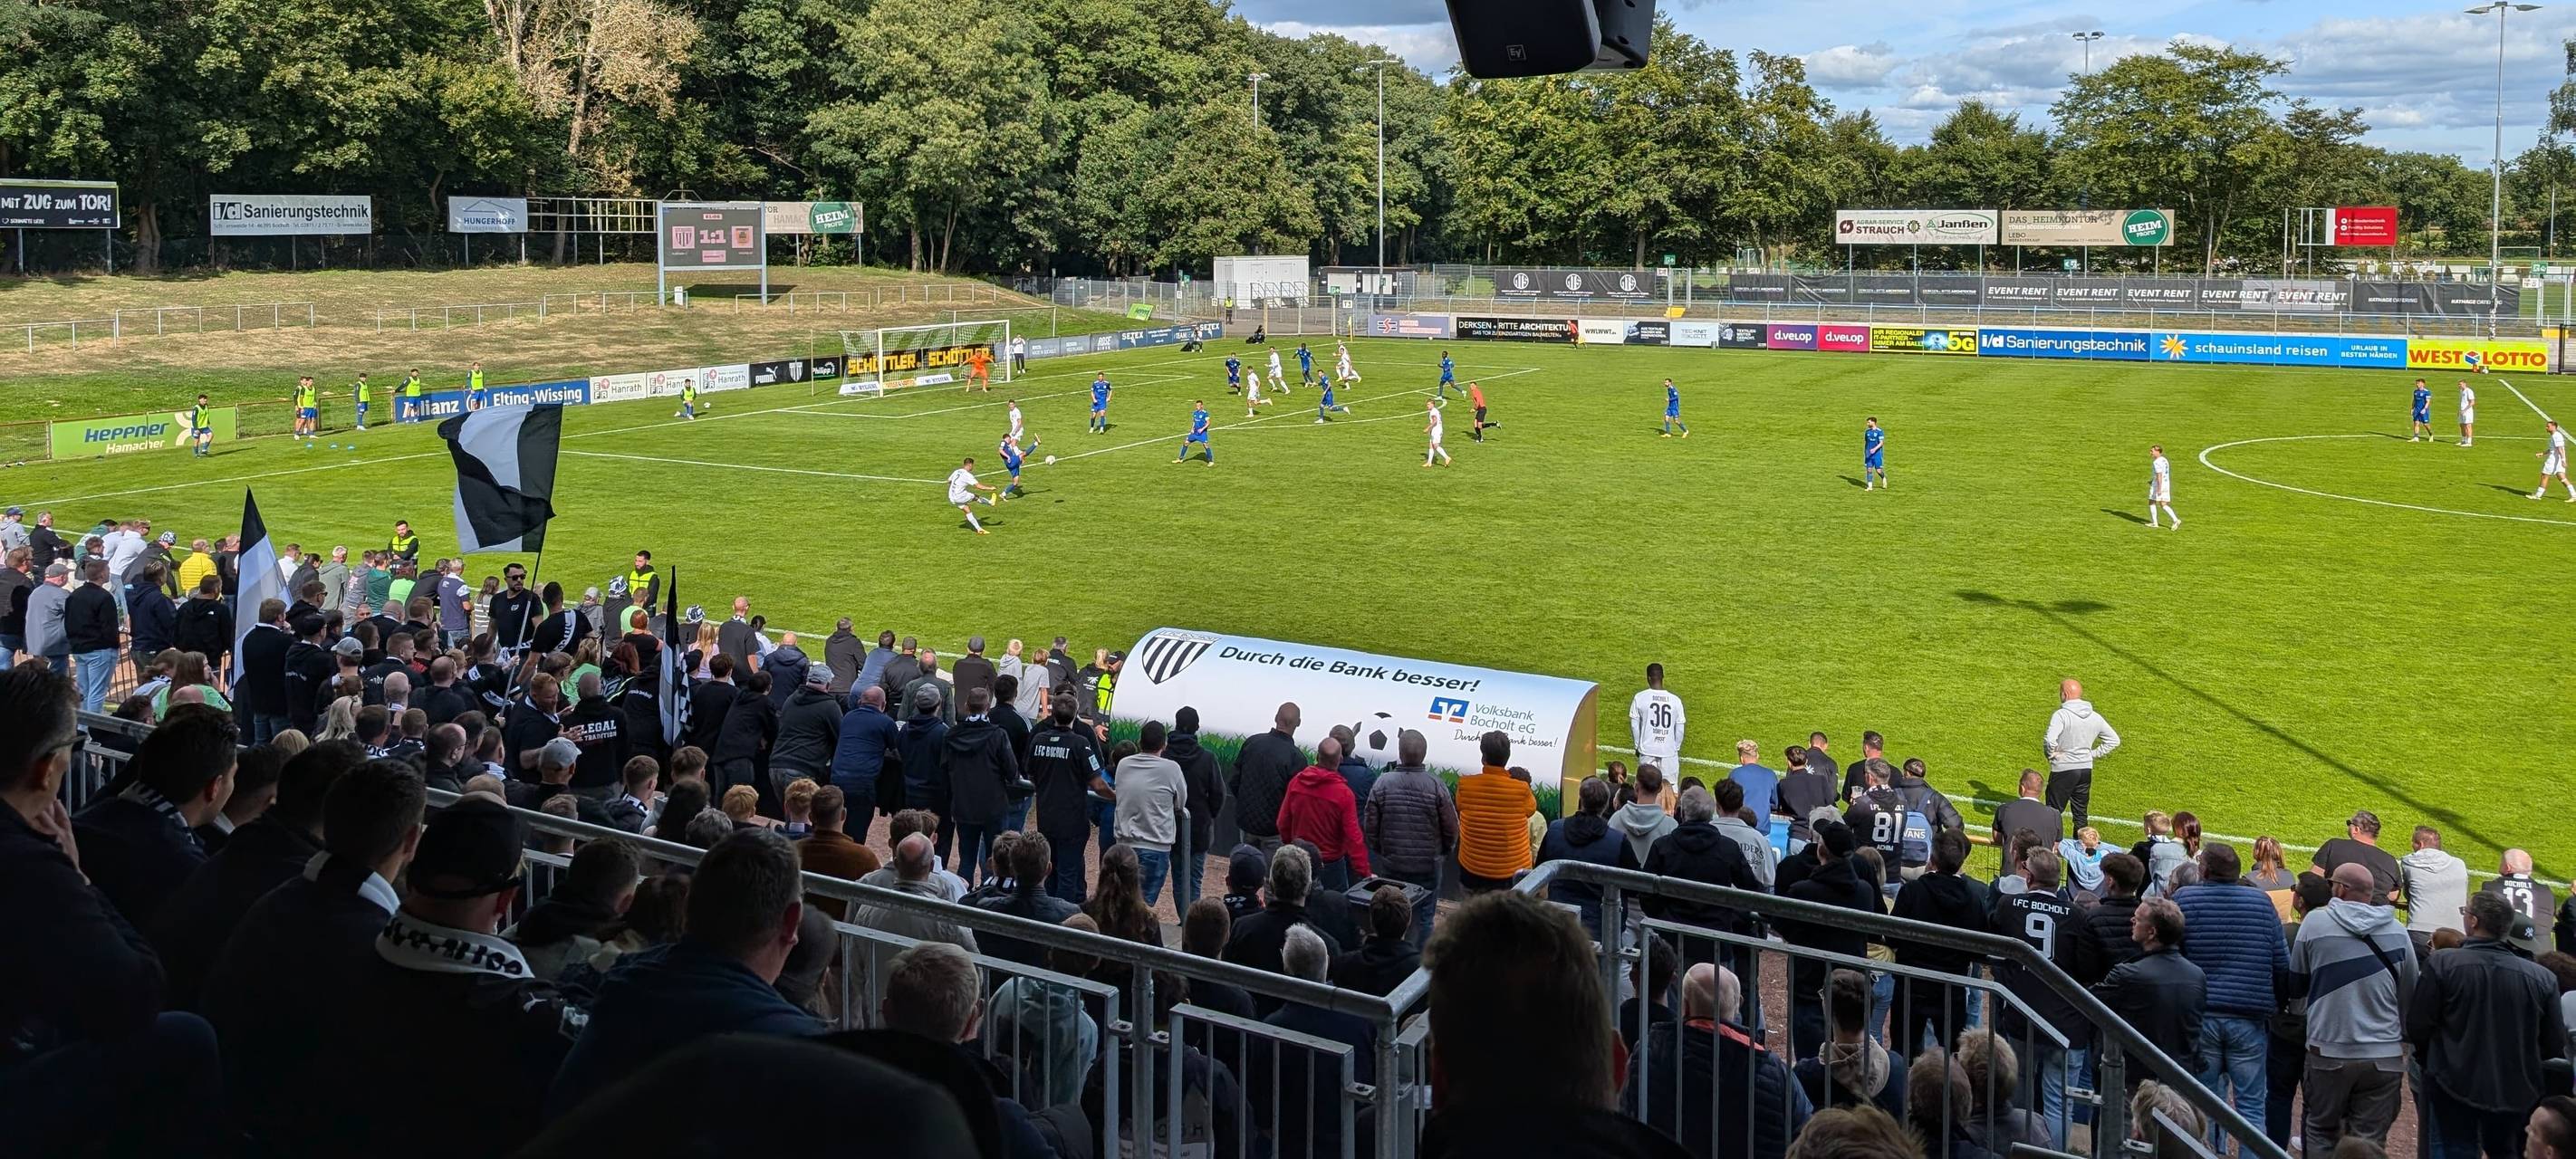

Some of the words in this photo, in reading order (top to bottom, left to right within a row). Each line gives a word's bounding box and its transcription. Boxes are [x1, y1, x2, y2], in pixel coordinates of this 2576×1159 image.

[24, 194, 53, 210] ZUG
[54, 199, 77, 210] ZUM
[79, 194, 111, 211] TOR!
[244, 204, 369, 221] Sanierungstechnik
[815, 209, 850, 225] HEIM
[463, 217, 515, 225] HUNGERHOFF
[1938, 219, 1988, 228] Janßen
[2008, 216, 2098, 225] DAS_HEIMKONTOR
[2128, 219, 2163, 234] HEIM
[699, 229, 726, 244] 1:1
[1856, 226, 1905, 235] STRAUCH
[1988, 287, 2020, 295] EVENT
[2022, 287, 2048, 295] RENT
[2057, 288, 2089, 296] EVENT
[2128, 289, 2160, 297] EVENT
[2163, 290, 2191, 298] RENT
[2202, 290, 2237, 299] EVENT
[2239, 291, 2268, 300] RENT
[2278, 291, 2314, 300] EVENT
[2317, 292, 2347, 301] RENT
[1199, 322, 1220, 331] SETEX
[1458, 321, 1492, 330] DERKSEN
[1498, 321, 1518, 330] RITTE
[1121, 331, 1144, 340] SETEX
[1774, 330, 1812, 344] d.velop
[1825, 331, 1864, 344] d.velop
[1947, 331, 1975, 351] 5G
[1982, 334, 2004, 348] i/d
[2006, 336, 2147, 353] Sanierungstechnik
[2195, 341, 2282, 355] schauinsland
[2286, 344, 2328, 356] reisen
[2409, 350, 2464, 364] WEST
[2483, 350, 2546, 367] LOTTO
[717, 375, 745, 384] Hanrath
[611, 384, 642, 394] Hanrath
[105, 439, 166, 454] Hamacher
[1219, 646, 1285, 666] Durch
[1289, 656, 1325, 671] die
[1328, 660, 1389, 680] Bank
[1391, 668, 1481, 692] besser!
[1475, 703, 1534, 721] Volksbank
[1649, 703, 1672, 729] 36
[1469, 714, 1515, 732] Bocholt
[1518, 723, 1536, 734] eG
[584, 731, 617, 742] TRADITION
[1508, 734, 1527, 745] ank
[1528, 736, 1559, 748] besser!
[1045, 746, 1070, 760] BOCHOLT
[1872, 812, 1902, 844] 81
[1903, 828, 1927, 838] VANS
[2504, 880, 2533, 889] BOCHOLT
[2031, 901, 2071, 915] BOCHOLT
[2503, 886, 2533, 919] 13
[2025, 912, 2055, 961] 9
